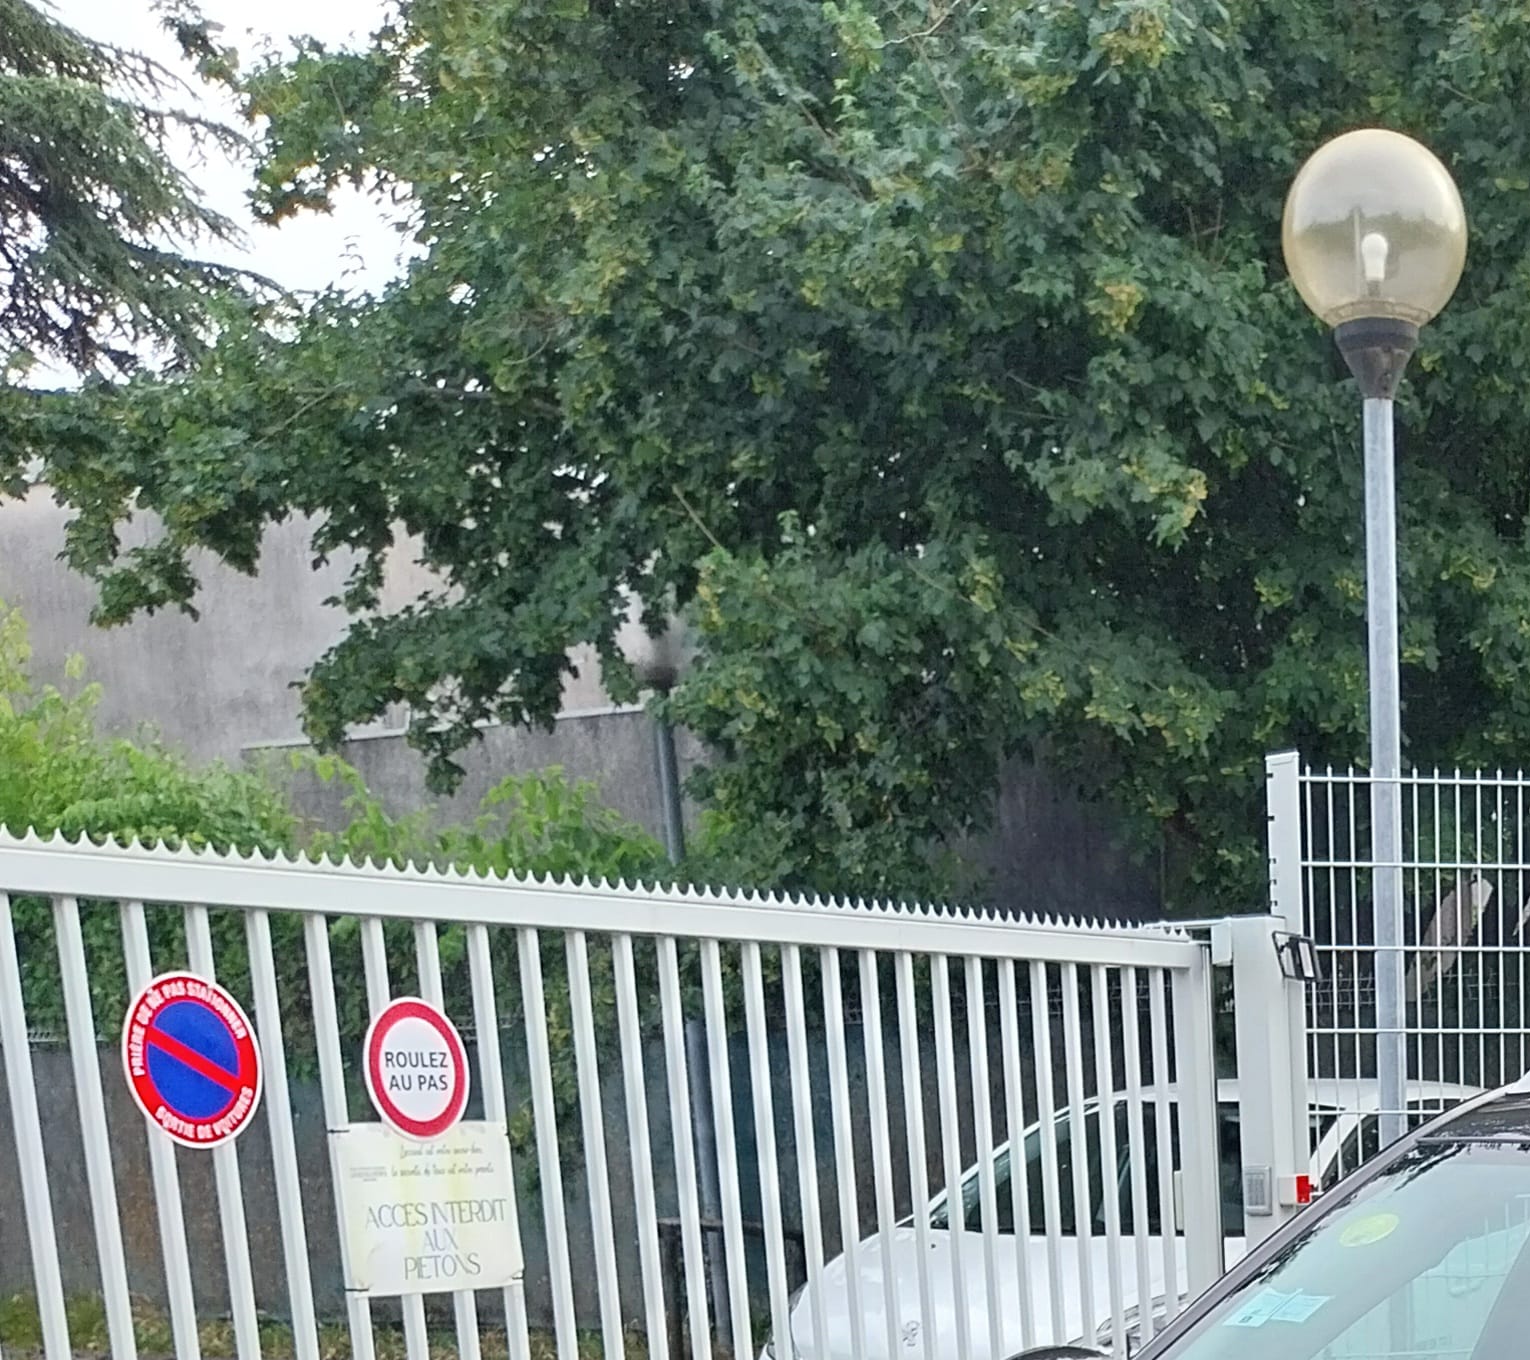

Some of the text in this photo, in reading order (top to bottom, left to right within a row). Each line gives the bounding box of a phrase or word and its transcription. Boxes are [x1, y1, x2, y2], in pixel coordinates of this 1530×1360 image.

[161, 981, 185, 999] PAS
[186, 981, 248, 1040] STATIONNER
[385, 1051, 448, 1068] ROULEZ
[389, 1074, 448, 1091] AU PAS
[155, 1086, 254, 1139] SORTIE DE VOITURES
[366, 1199, 507, 1229] ACCES INTERDIT
[424, 1229, 459, 1252] AUX
[405, 1253, 481, 1281] PIETONS
